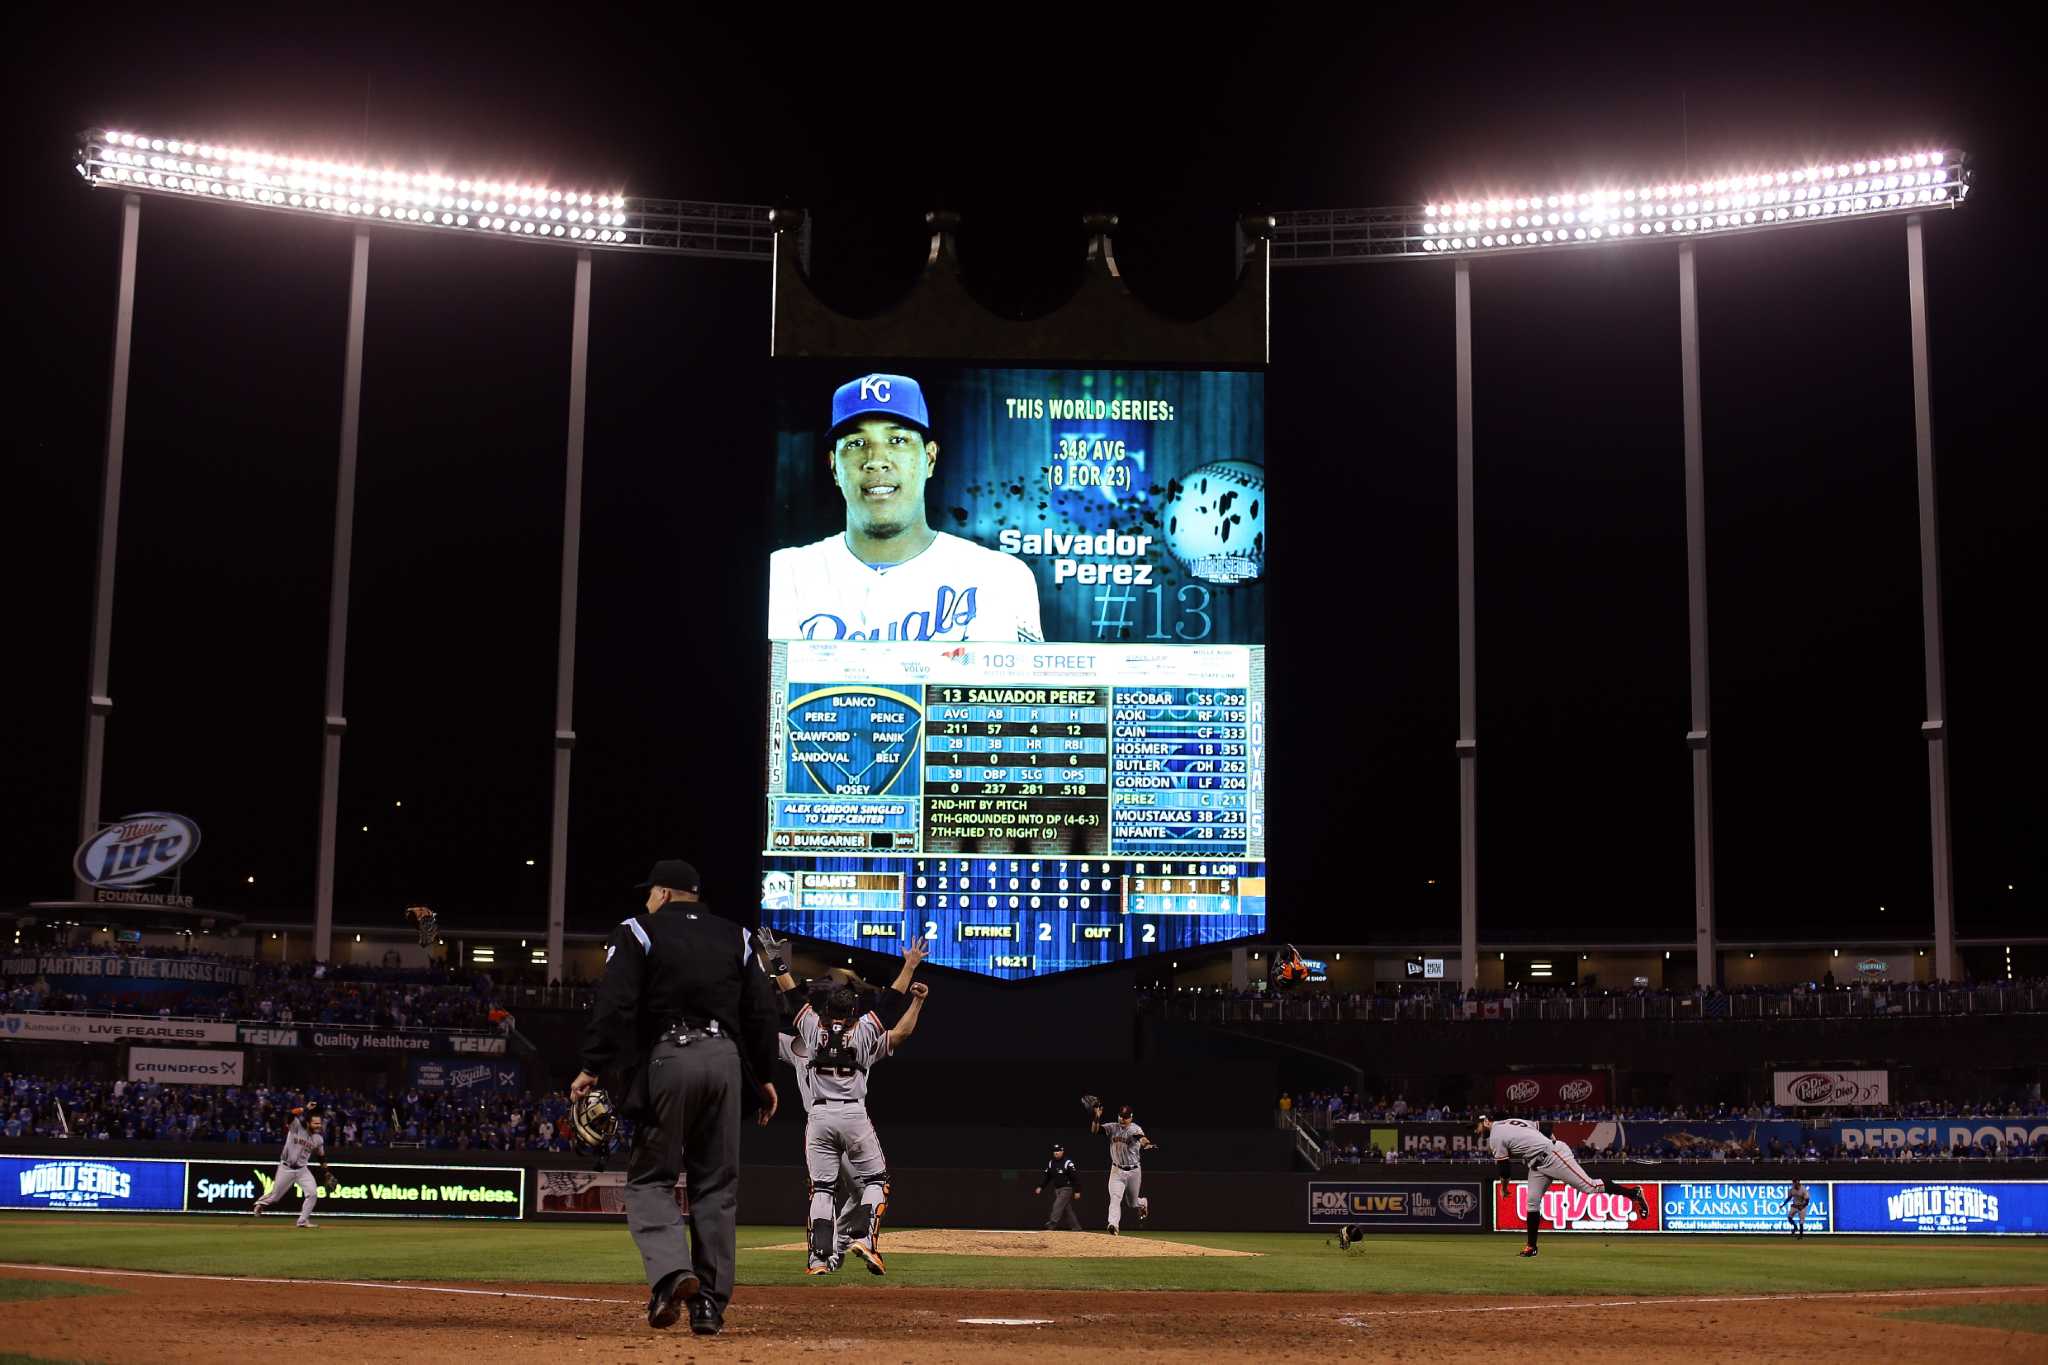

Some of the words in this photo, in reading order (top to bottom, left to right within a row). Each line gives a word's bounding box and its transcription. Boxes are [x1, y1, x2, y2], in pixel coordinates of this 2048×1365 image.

[861, 378, 891, 403] KC
[1006, 398, 1045, 420] THIS
[1049, 399, 1106, 420] WORLD
[1110, 400, 1174, 421] SERIES:
[1054, 440, 1087, 460] .348
[1093, 440, 1126, 460] AVG
[1048, 465, 1064, 491] (8
[1069, 466, 1101, 486] FOR
[1106, 466, 1130, 491] 23)
[1000, 529, 1153, 556] Salvador
[1055, 559, 1153, 586] Perez
[1091, 585, 1211, 640] #13
[983, 655, 1015, 668] 103
[1033, 655, 1097, 669] STREET
[832, 697, 876, 708] BLANCO
[943, 690, 961, 703] 13
[968, 690, 1046, 703] SALVADOR
[1050, 690, 1096, 704] PEREZ
[1116, 693, 1173, 705] ESCOBAR
[1198, 695, 1212, 706] SS
[1219, 694, 1246, 706] .292
[805, 712, 837, 722] PEREZ
[870, 713, 905, 723] PENCE
[944, 709, 969, 719] AVG
[987, 709, 1003, 719] AB
[1031, 710, 1039, 719] R
[1070, 711, 1078, 720] H
[1116, 710, 1146, 721] AOKI
[1198, 711, 1212, 722] RF
[1220, 711, 1246, 722] .195
[943, 724, 968, 734] .211
[988, 724, 1002, 734] 57
[1029, 725, 1038, 735] 4
[1066, 725, 1081, 735] 12
[1116, 727, 1146, 737] CAIN
[1198, 728, 1212, 738] CF
[1219, 727, 1245, 739] .333
[790, 732, 850, 742] CRAWFORD
[872, 732, 905, 743] PANIK
[949, 739, 963, 749] 2B
[988, 739, 1002, 749] 3B
[1026, 740, 1042, 750] HR
[1064, 740, 1083, 750] RBI
[1116, 744, 1168, 755] HOSMER
[1199, 745, 1213, 755] 1B
[1219, 744, 1245, 755] .351
[791, 752, 850, 763] SANDOVAL
[875, 753, 900, 763] BELT
[1116, 760, 1160, 771] BUTLER
[1197, 760, 1213, 771] DH
[1219, 760, 1245, 772] .262
[948, 770, 962, 779] SB
[983, 770, 1006, 779] OBP
[1021, 770, 1042, 780] SLG
[1062, 771, 1084, 780] OPS
[1116, 776, 1170, 788] GORDON
[1198, 777, 1212, 788] LF
[1219, 777, 1246, 789] .204
[836, 785, 870, 794] POSEY
[981, 784, 1006, 794] .237
[1018, 784, 1043, 795] .281
[1060, 785, 1086, 795] .518
[931, 800, 976, 810] 2ND-HIT
[979, 800, 993, 810] BY
[996, 801, 1027, 811] PITCH
[1116, 794, 1155, 805] PEREZ
[784, 805, 811, 814] ALEX
[812, 805, 859, 814] GORDON
[861, 805, 904, 815] SINGLED
[1115, 810, 1191, 822] MOUSTAKAS
[1197, 811, 1213, 822] 3B
[1219, 811, 1245, 823] .231
[805, 815, 818, 823] TO
[820, 815, 885, 824] LEFT-CENTER
[931, 814, 1015, 824] 4TH-GROUNDED
[1018, 815, 1044, 825] INTO
[1046, 815, 1062, 825] DP
[1064, 815, 1099, 827] (4-6-3)
[111, 823, 167, 842] Miller
[931, 827, 985, 837] 7TH-FLIED
[988, 827, 1002, 838] TO
[1006, 828, 1039, 839] RIGHT
[1042, 828, 1057, 840] (9)
[1115, 826, 1167, 838] INFANTE
[1197, 828, 1213, 839] 2B
[1219, 828, 1246, 839] .255
[775, 835, 789, 846] 40
[793, 835, 865, 847] BUMGARNER
[895, 837, 913, 845] MPH
[96, 834, 183, 883] Lite
[918, 861, 924, 871] 1
[939, 861, 947, 871] 2
[960, 861, 969, 871] 3
[988, 862, 996, 872] 4
[1136, 864, 1144, 874] R
[1163, 864, 1171, 874] H
[1213, 864, 1237, 874] LOB
[804, 875, 857, 888] GIANTS
[1136, 879, 1144, 891] 3
[98, 891, 164, 905] FOUNTAIN
[167, 895, 193, 907] BAR
[804, 893, 859, 906] ROYALS
[862, 924, 896, 936] BALL
[924, 921, 938, 940] 2
[964, 926, 1011, 937] STRIKE
[1038, 923, 1052, 941] 2
[1085, 927, 1111, 938] OUT
[1142, 924, 1156, 943] 2
[994, 956, 1027, 968] 10:21
[38, 958, 101, 976] PARTNER
[105, 959, 124, 976] OF
[130, 959, 156, 977] THE
[160, 961, 214, 982] KANSAS
[215, 966, 237, 984] CITY
[24, 1021, 57, 1034] Kansas
[59, 1021, 81, 1034] City
[89, 1025, 122, 1035] LIVE
[127, 1026, 206, 1038] FEARLESS
[240, 1029, 298, 1046] TEVA
[314, 1033, 358, 1049] Quality
[363, 1034, 430, 1049] Healthcare
[449, 1037, 506, 1053] TEVA
[135, 1062, 219, 1074] GRUNDFOS
[448, 1064, 494, 1088] Royals
[1835, 1086, 1855, 1098] Diet
[1404, 1136, 1447, 1151] H&R
[19, 1166, 75, 1196] WORLD
[78, 1167, 131, 1198] SERIES
[197, 1179, 254, 1202] Sprint
[370, 1184, 419, 1201] Value
[421, 1184, 438, 1201] in
[440, 1186, 518, 1202] Wireless.
[1680, 1184, 1712, 1199] THE
[1312, 1192, 1348, 1208] FOX
[1354, 1197, 1404, 1211] LIVE
[1447, 1194, 1468, 1204] FOX
[1412, 1207, 1437, 1217] NIGHTLY
[1665, 1202, 1685, 1215] OF
[1690, 1201, 1748, 1215] KANSAS
[1888, 1190, 1942, 1221] WORLD
[1945, 1191, 1999, 1222] SERIES
[1668, 1220, 1695, 1230] Official
[1697, 1220, 1738, 1230] Healthcare
[1740, 1220, 1772, 1230] Provider
[1774, 1220, 1782, 1230] of
